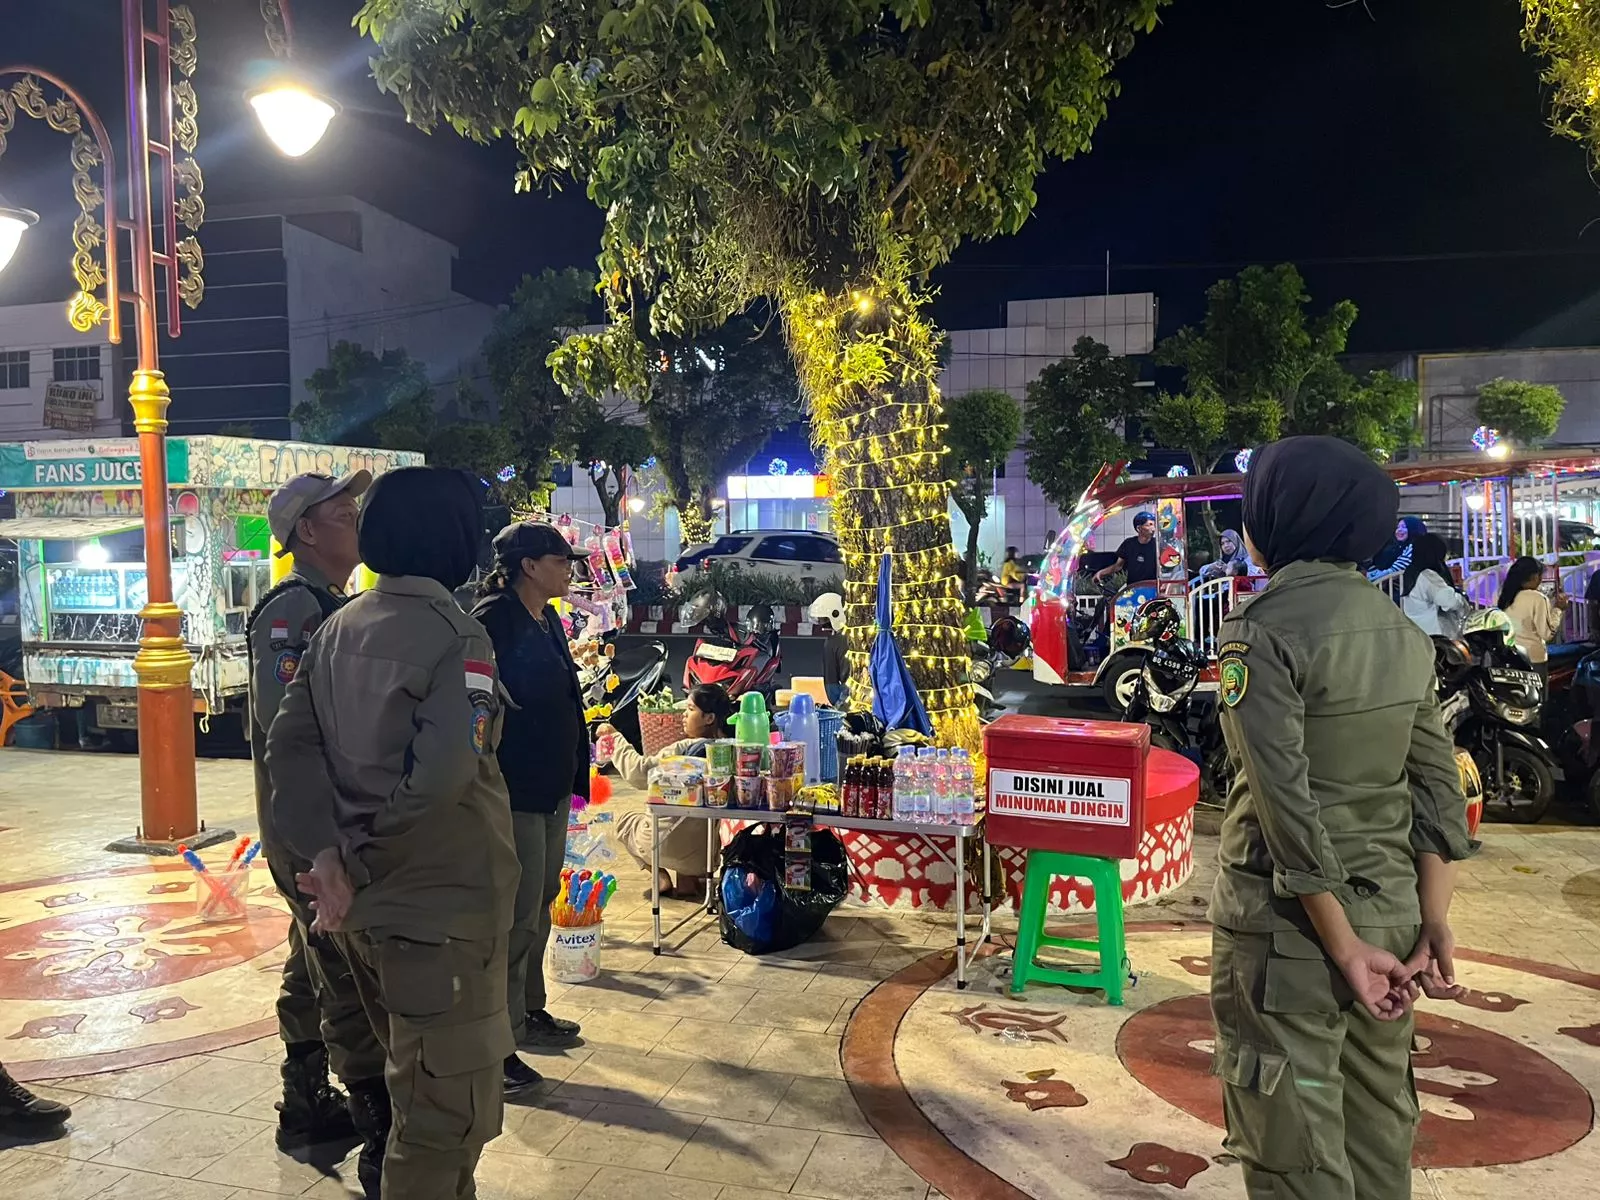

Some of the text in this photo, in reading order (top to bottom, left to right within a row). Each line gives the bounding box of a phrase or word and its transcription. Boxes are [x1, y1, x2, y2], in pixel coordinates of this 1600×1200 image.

[78, 391, 93, 400] INI
[35, 461, 142, 483] FANS JUICE
[258, 444, 334, 484] FANS
[1013, 776, 1105, 798] DISINI JUAL
[995, 794, 1066, 814] MINUMAN
[1070, 801, 1123, 819] DINGIN
[556, 933, 596, 945] Avitex
